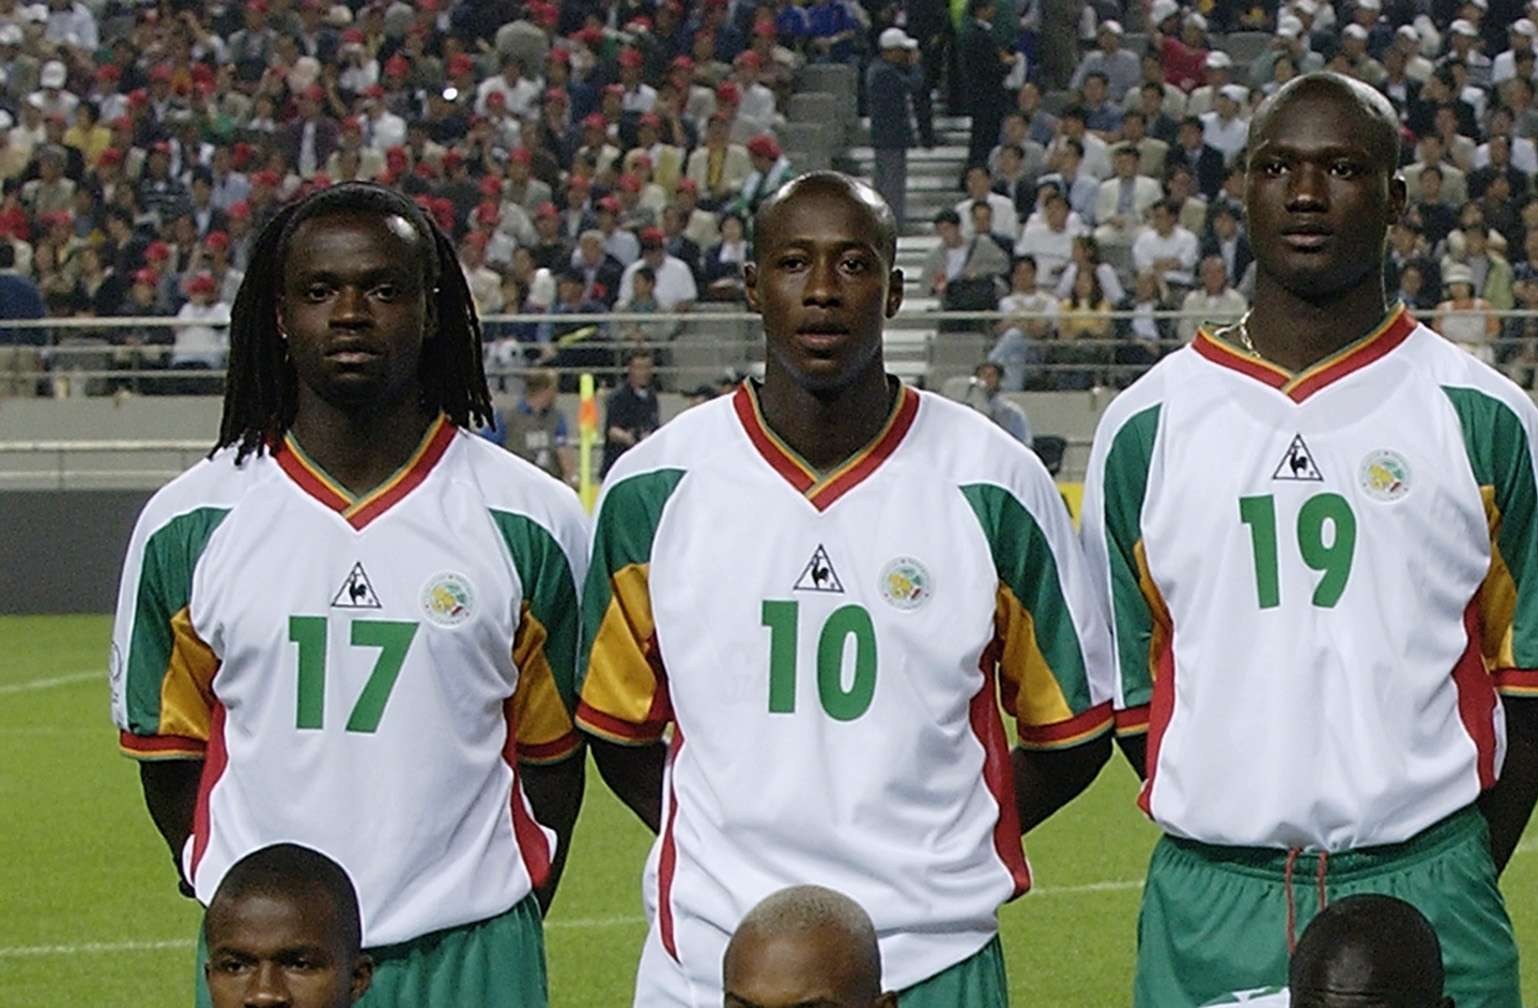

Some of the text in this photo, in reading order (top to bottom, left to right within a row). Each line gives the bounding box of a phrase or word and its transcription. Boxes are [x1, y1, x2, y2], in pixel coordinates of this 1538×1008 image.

[1239, 493, 1357, 609] 19
[288, 614, 419, 734] 17
[762, 599, 878, 722] 10
